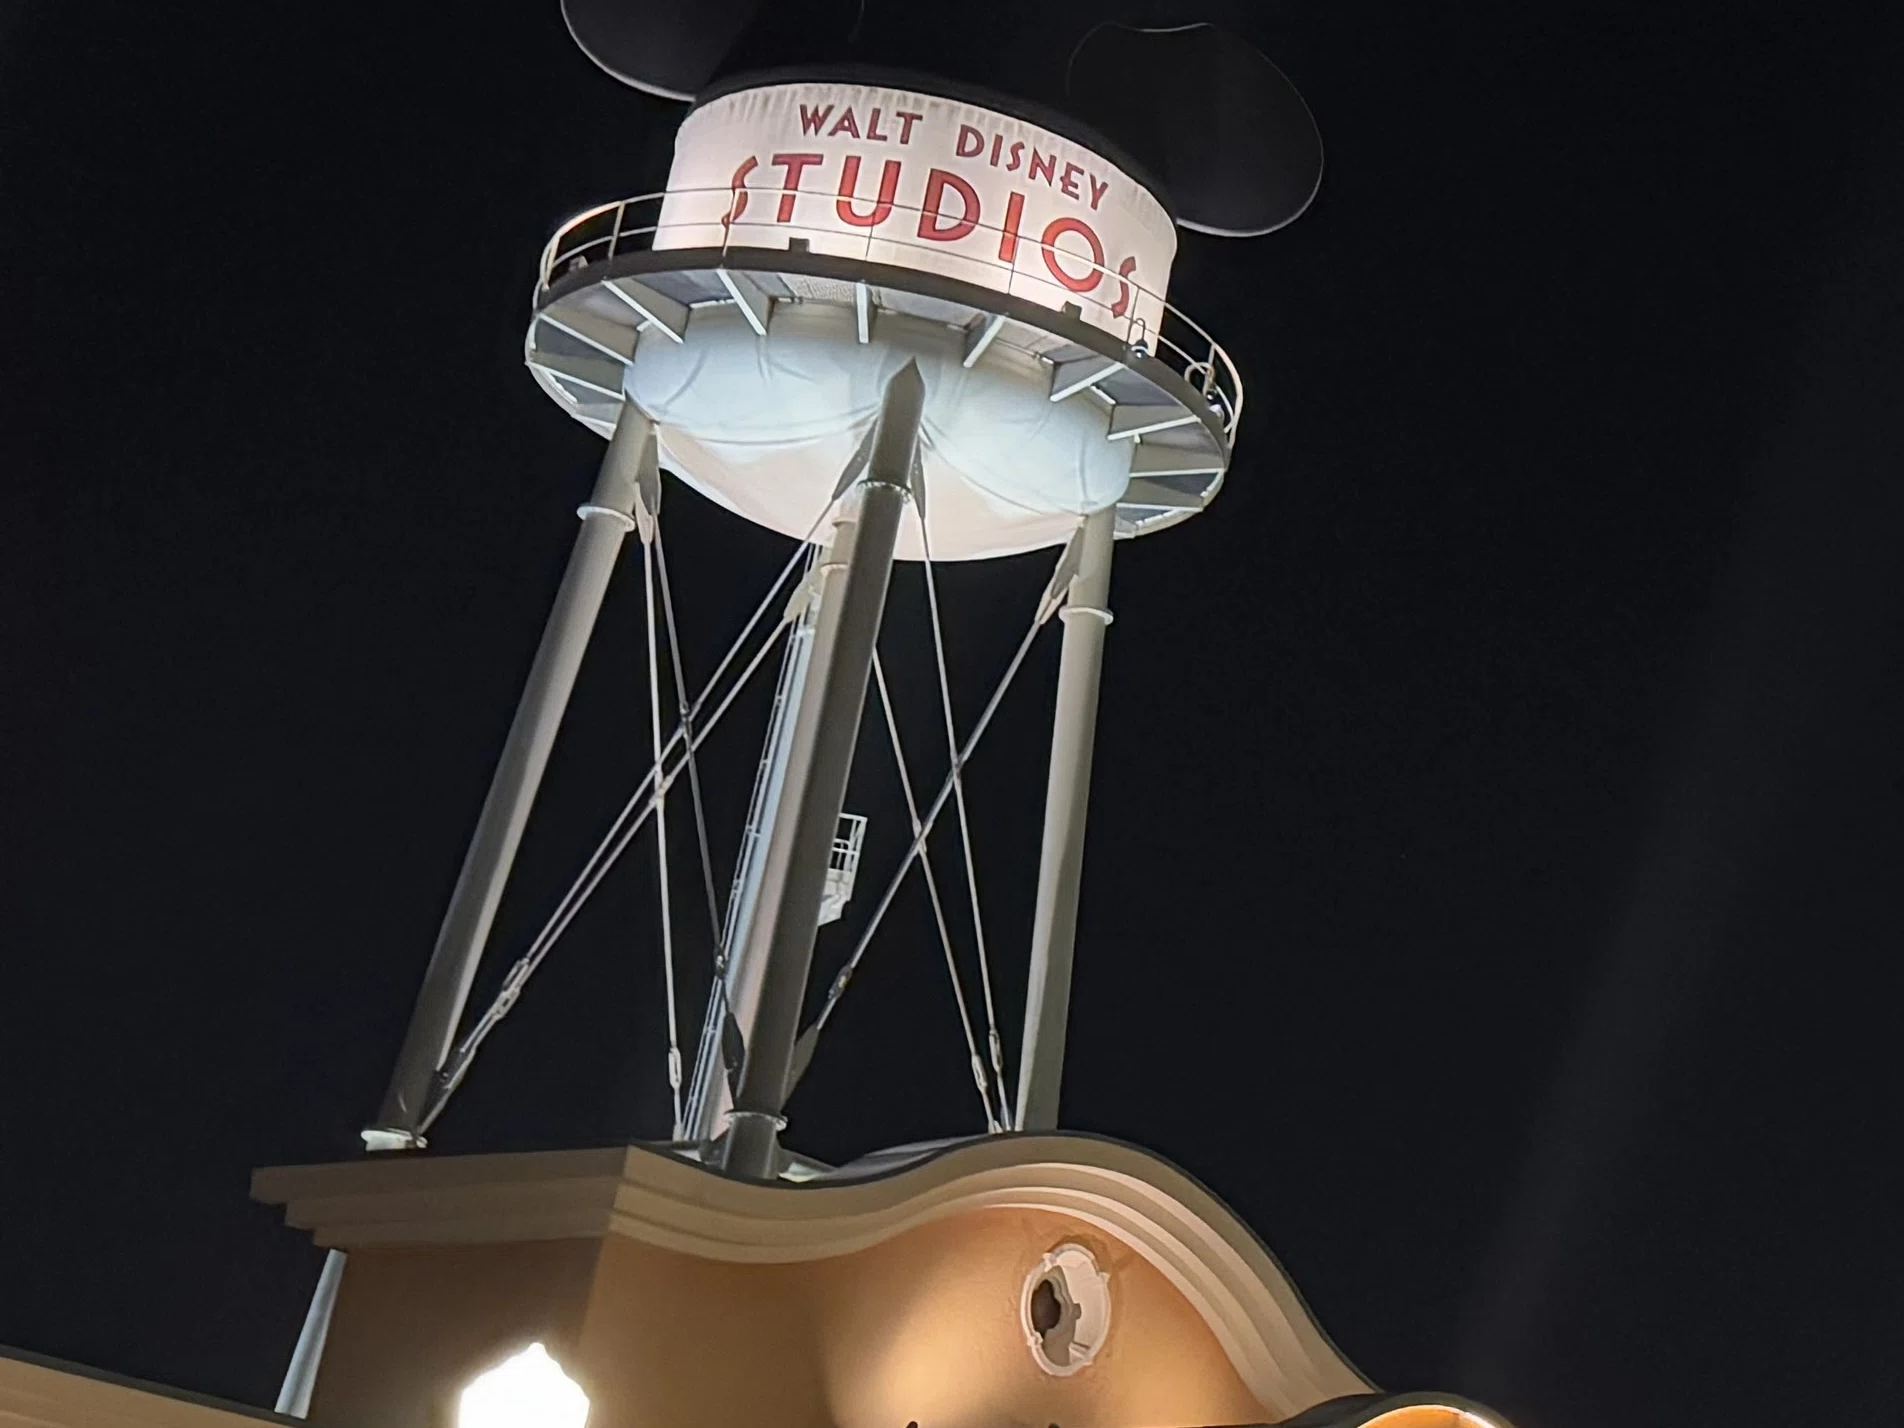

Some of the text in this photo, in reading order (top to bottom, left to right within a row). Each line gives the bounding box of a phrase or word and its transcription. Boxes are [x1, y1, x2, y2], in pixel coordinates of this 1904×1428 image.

[799, 103, 1109, 211] WALT DISNEY
[721, 153, 1137, 318] STUDIOS
